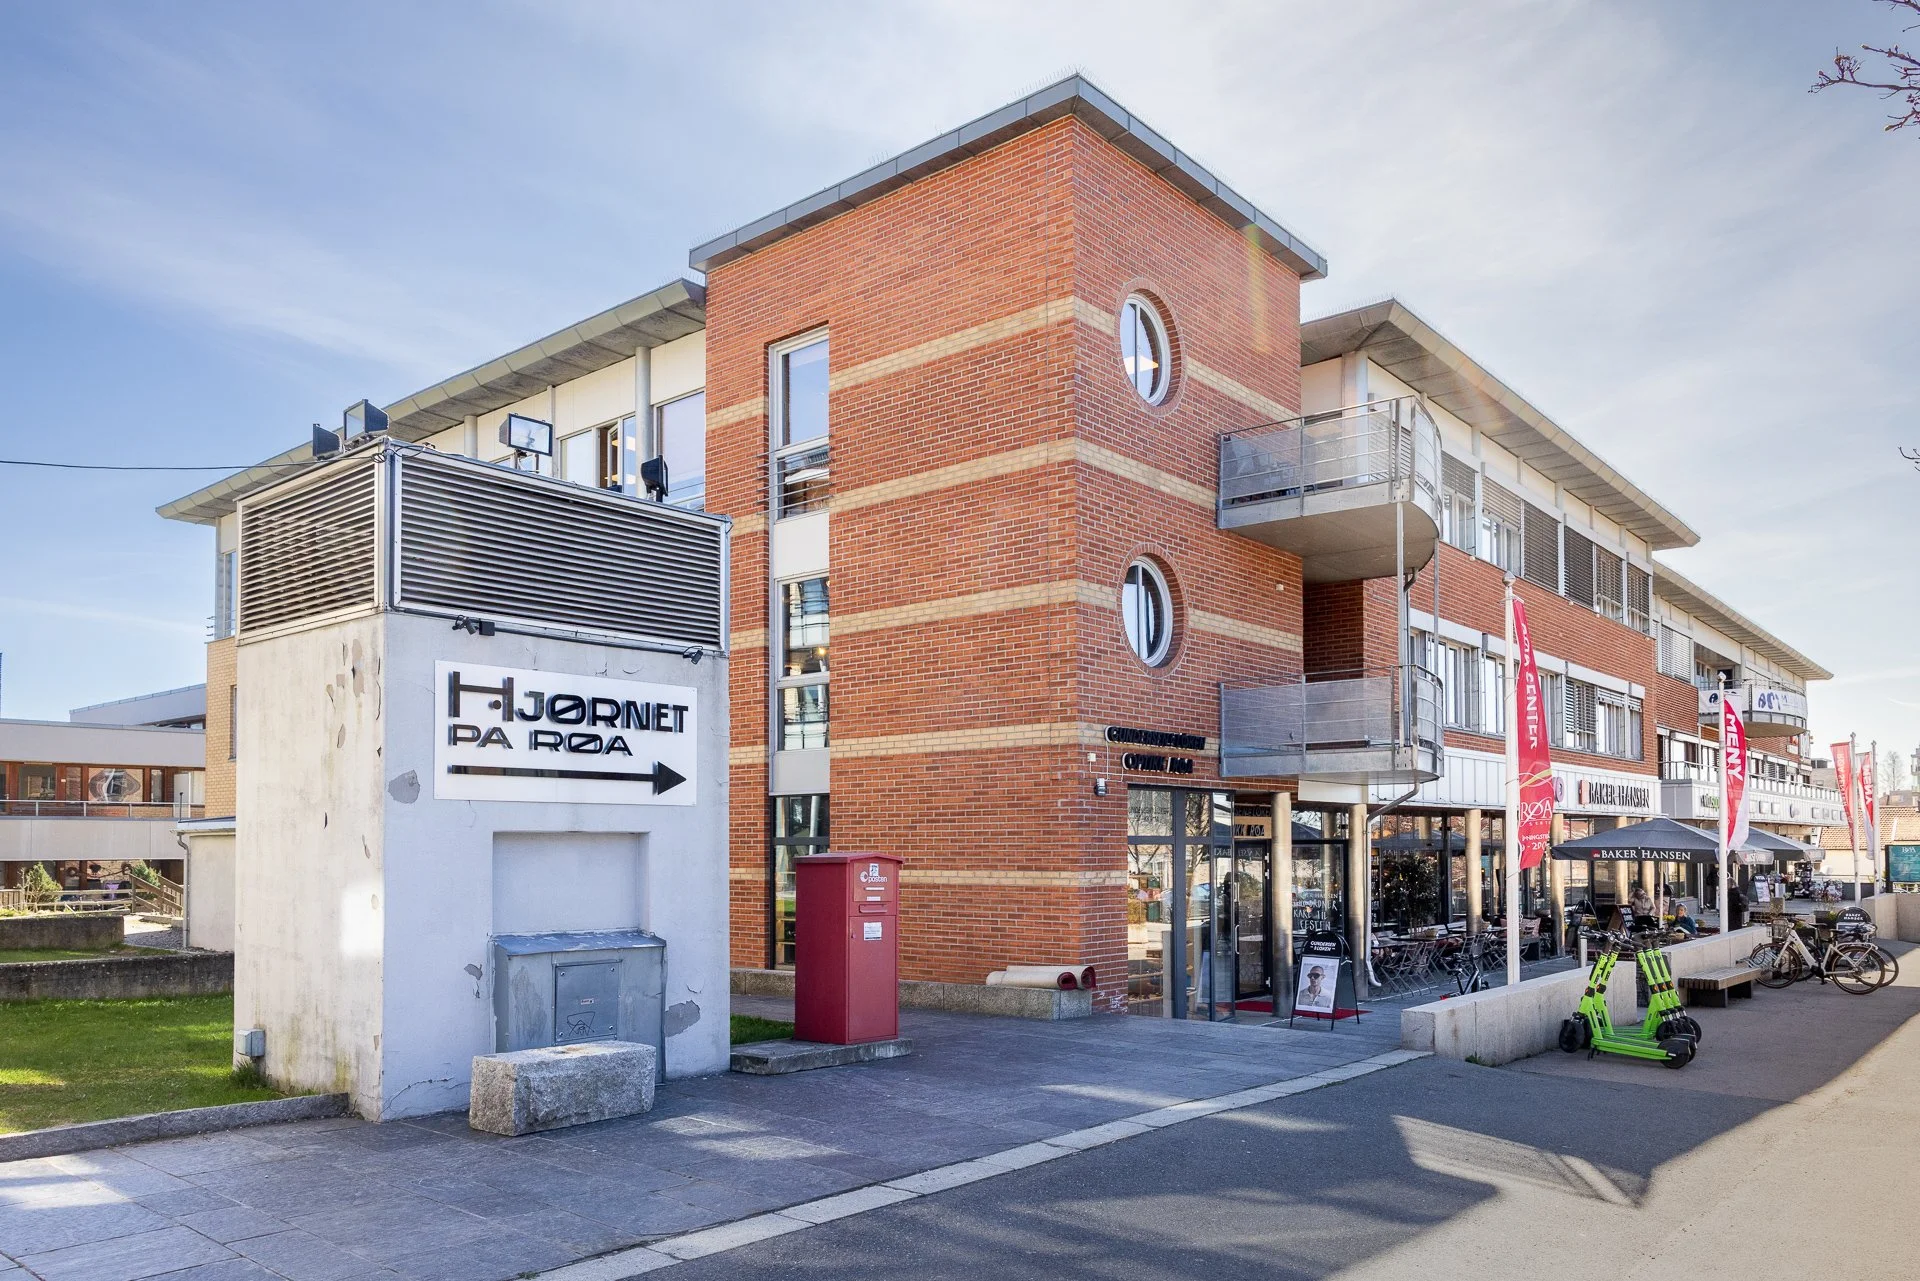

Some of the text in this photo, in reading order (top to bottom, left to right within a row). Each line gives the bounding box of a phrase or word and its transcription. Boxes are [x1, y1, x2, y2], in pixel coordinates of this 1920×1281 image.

[449, 671, 689, 733] HJØRNET
[529, 730, 633, 757] RØA
[1725, 713, 1745, 781] MENY
[1589, 782, 1650, 809] BAKER HANSEN
[1601, 849, 1691, 861] BAKER HANSEN
